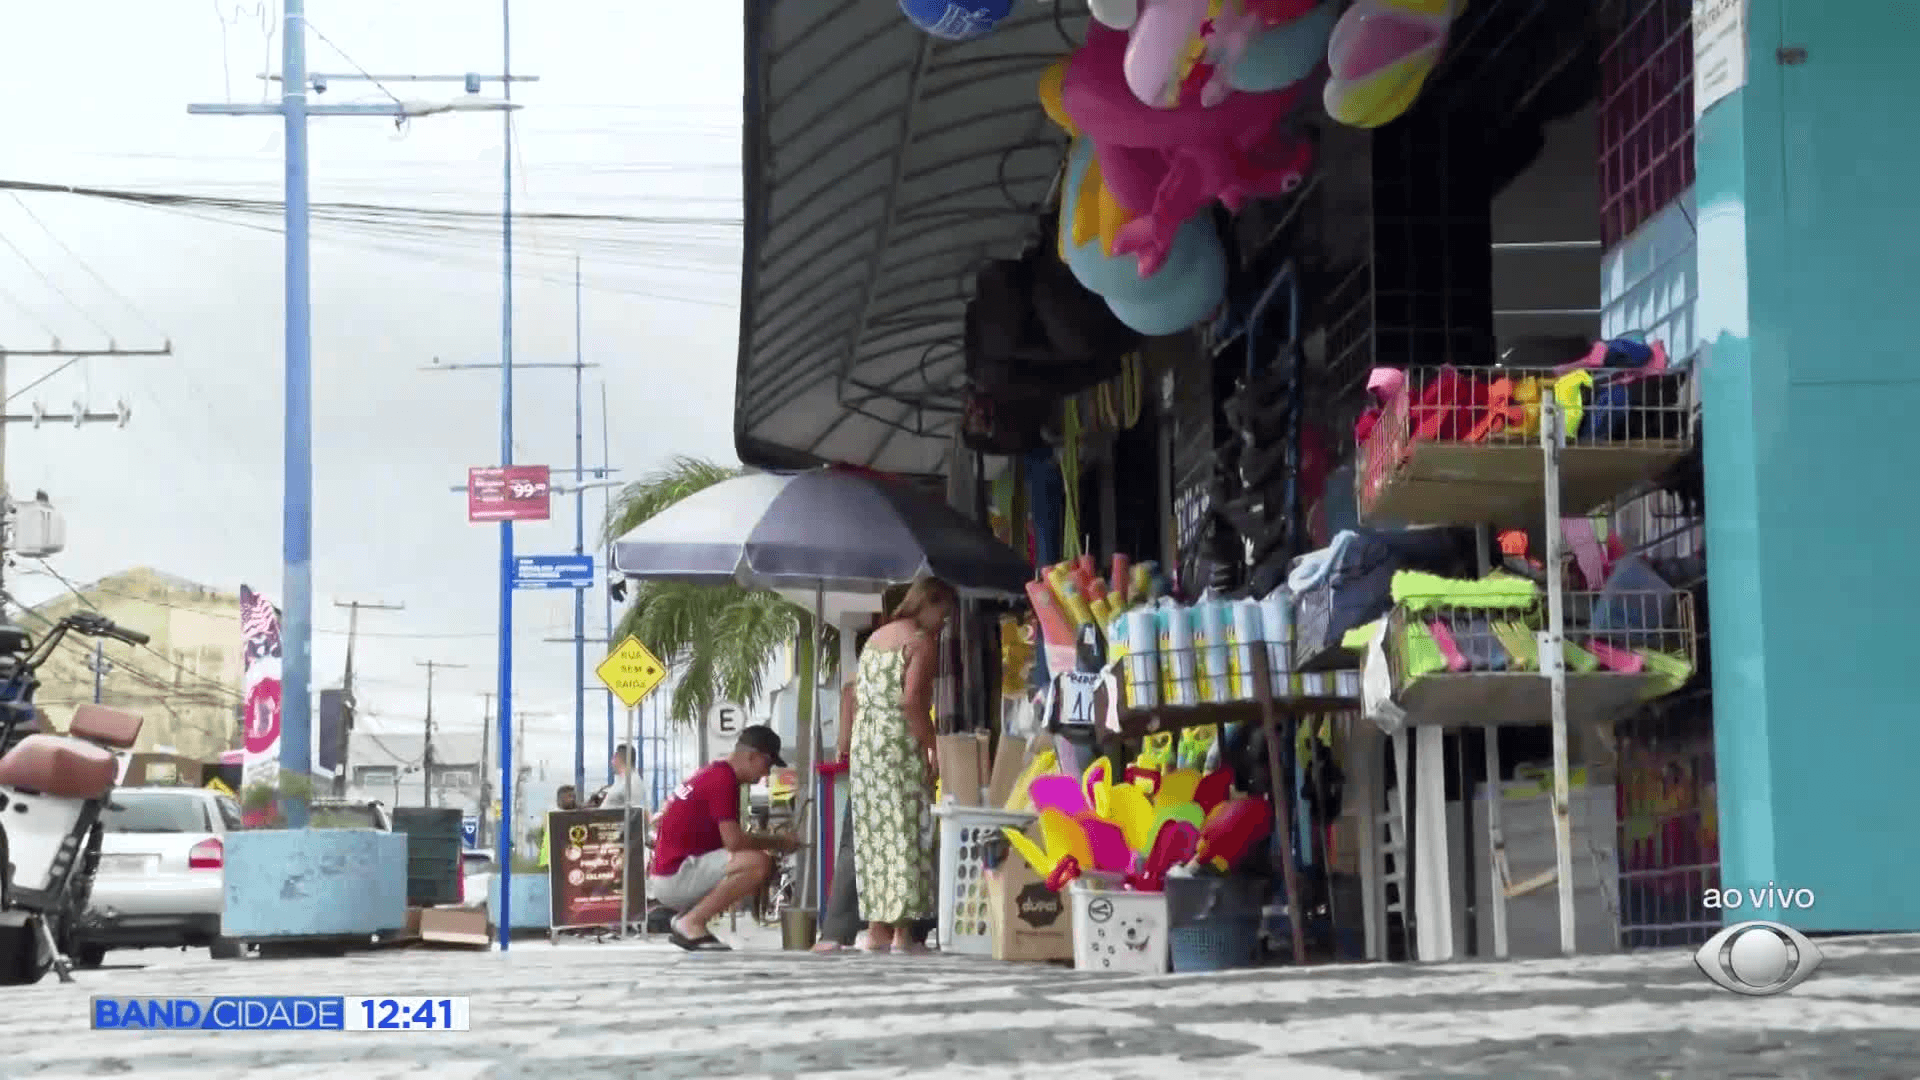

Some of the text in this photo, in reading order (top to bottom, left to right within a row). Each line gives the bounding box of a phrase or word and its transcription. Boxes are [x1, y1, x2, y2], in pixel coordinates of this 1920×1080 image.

[620, 651, 642, 660] RUA
[620, 665, 642, 674] SEM
[720, 708, 736, 731] E
